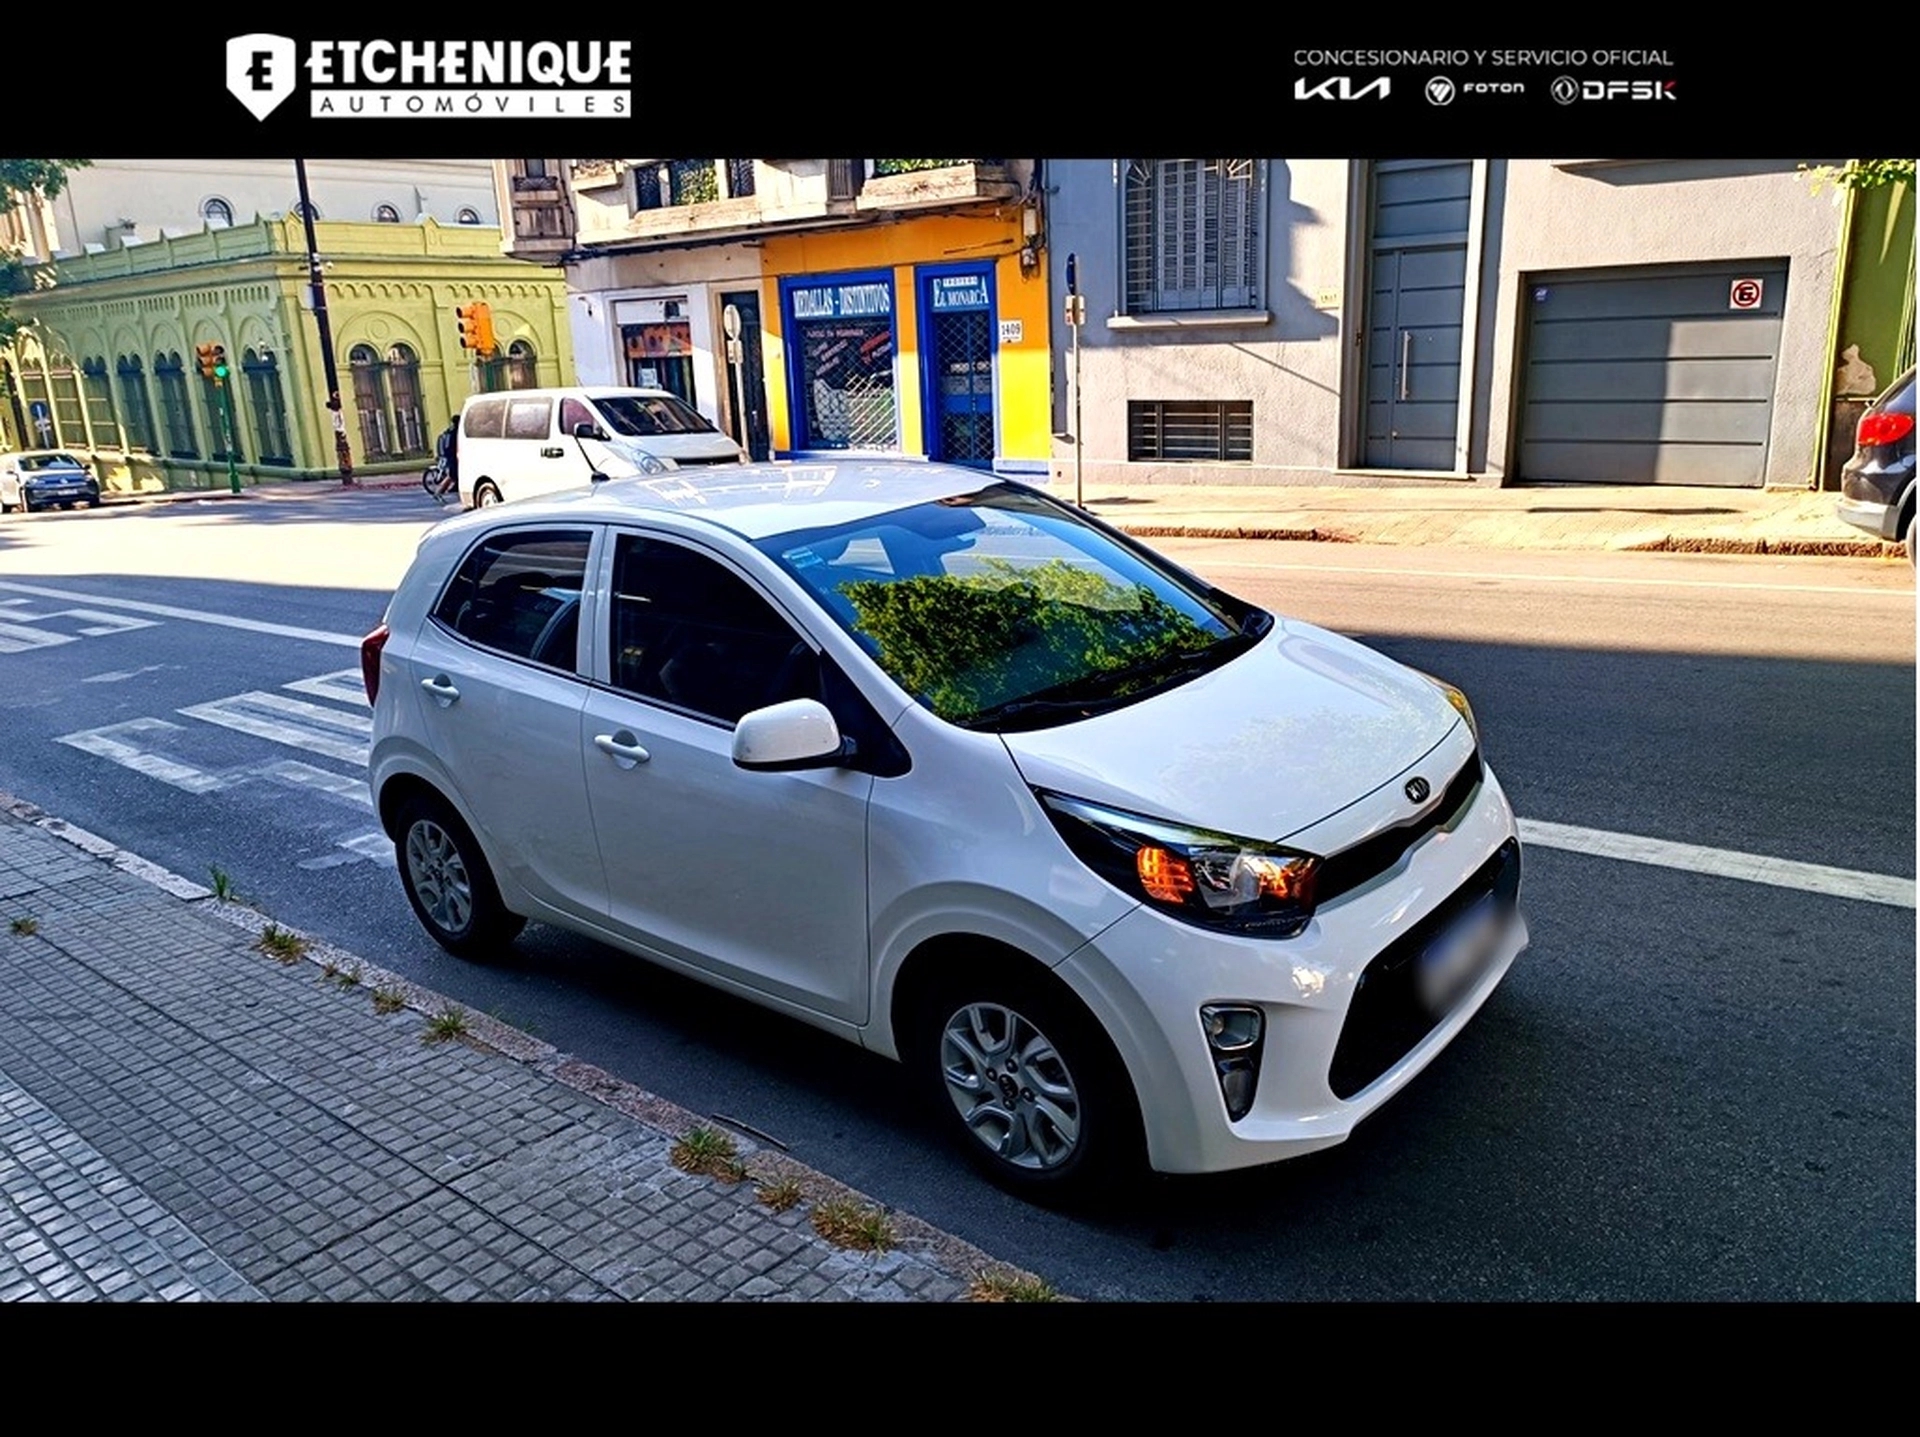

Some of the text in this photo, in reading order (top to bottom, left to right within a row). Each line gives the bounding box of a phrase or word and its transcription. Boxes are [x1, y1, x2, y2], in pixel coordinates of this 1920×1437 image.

[793, 287, 833, 318] MEDALLAS
[839, 283, 891, 315] DISTINTIVOS
[948, 276, 989, 307] MONARCA
[1001, 323, 1021, 336] 1409
